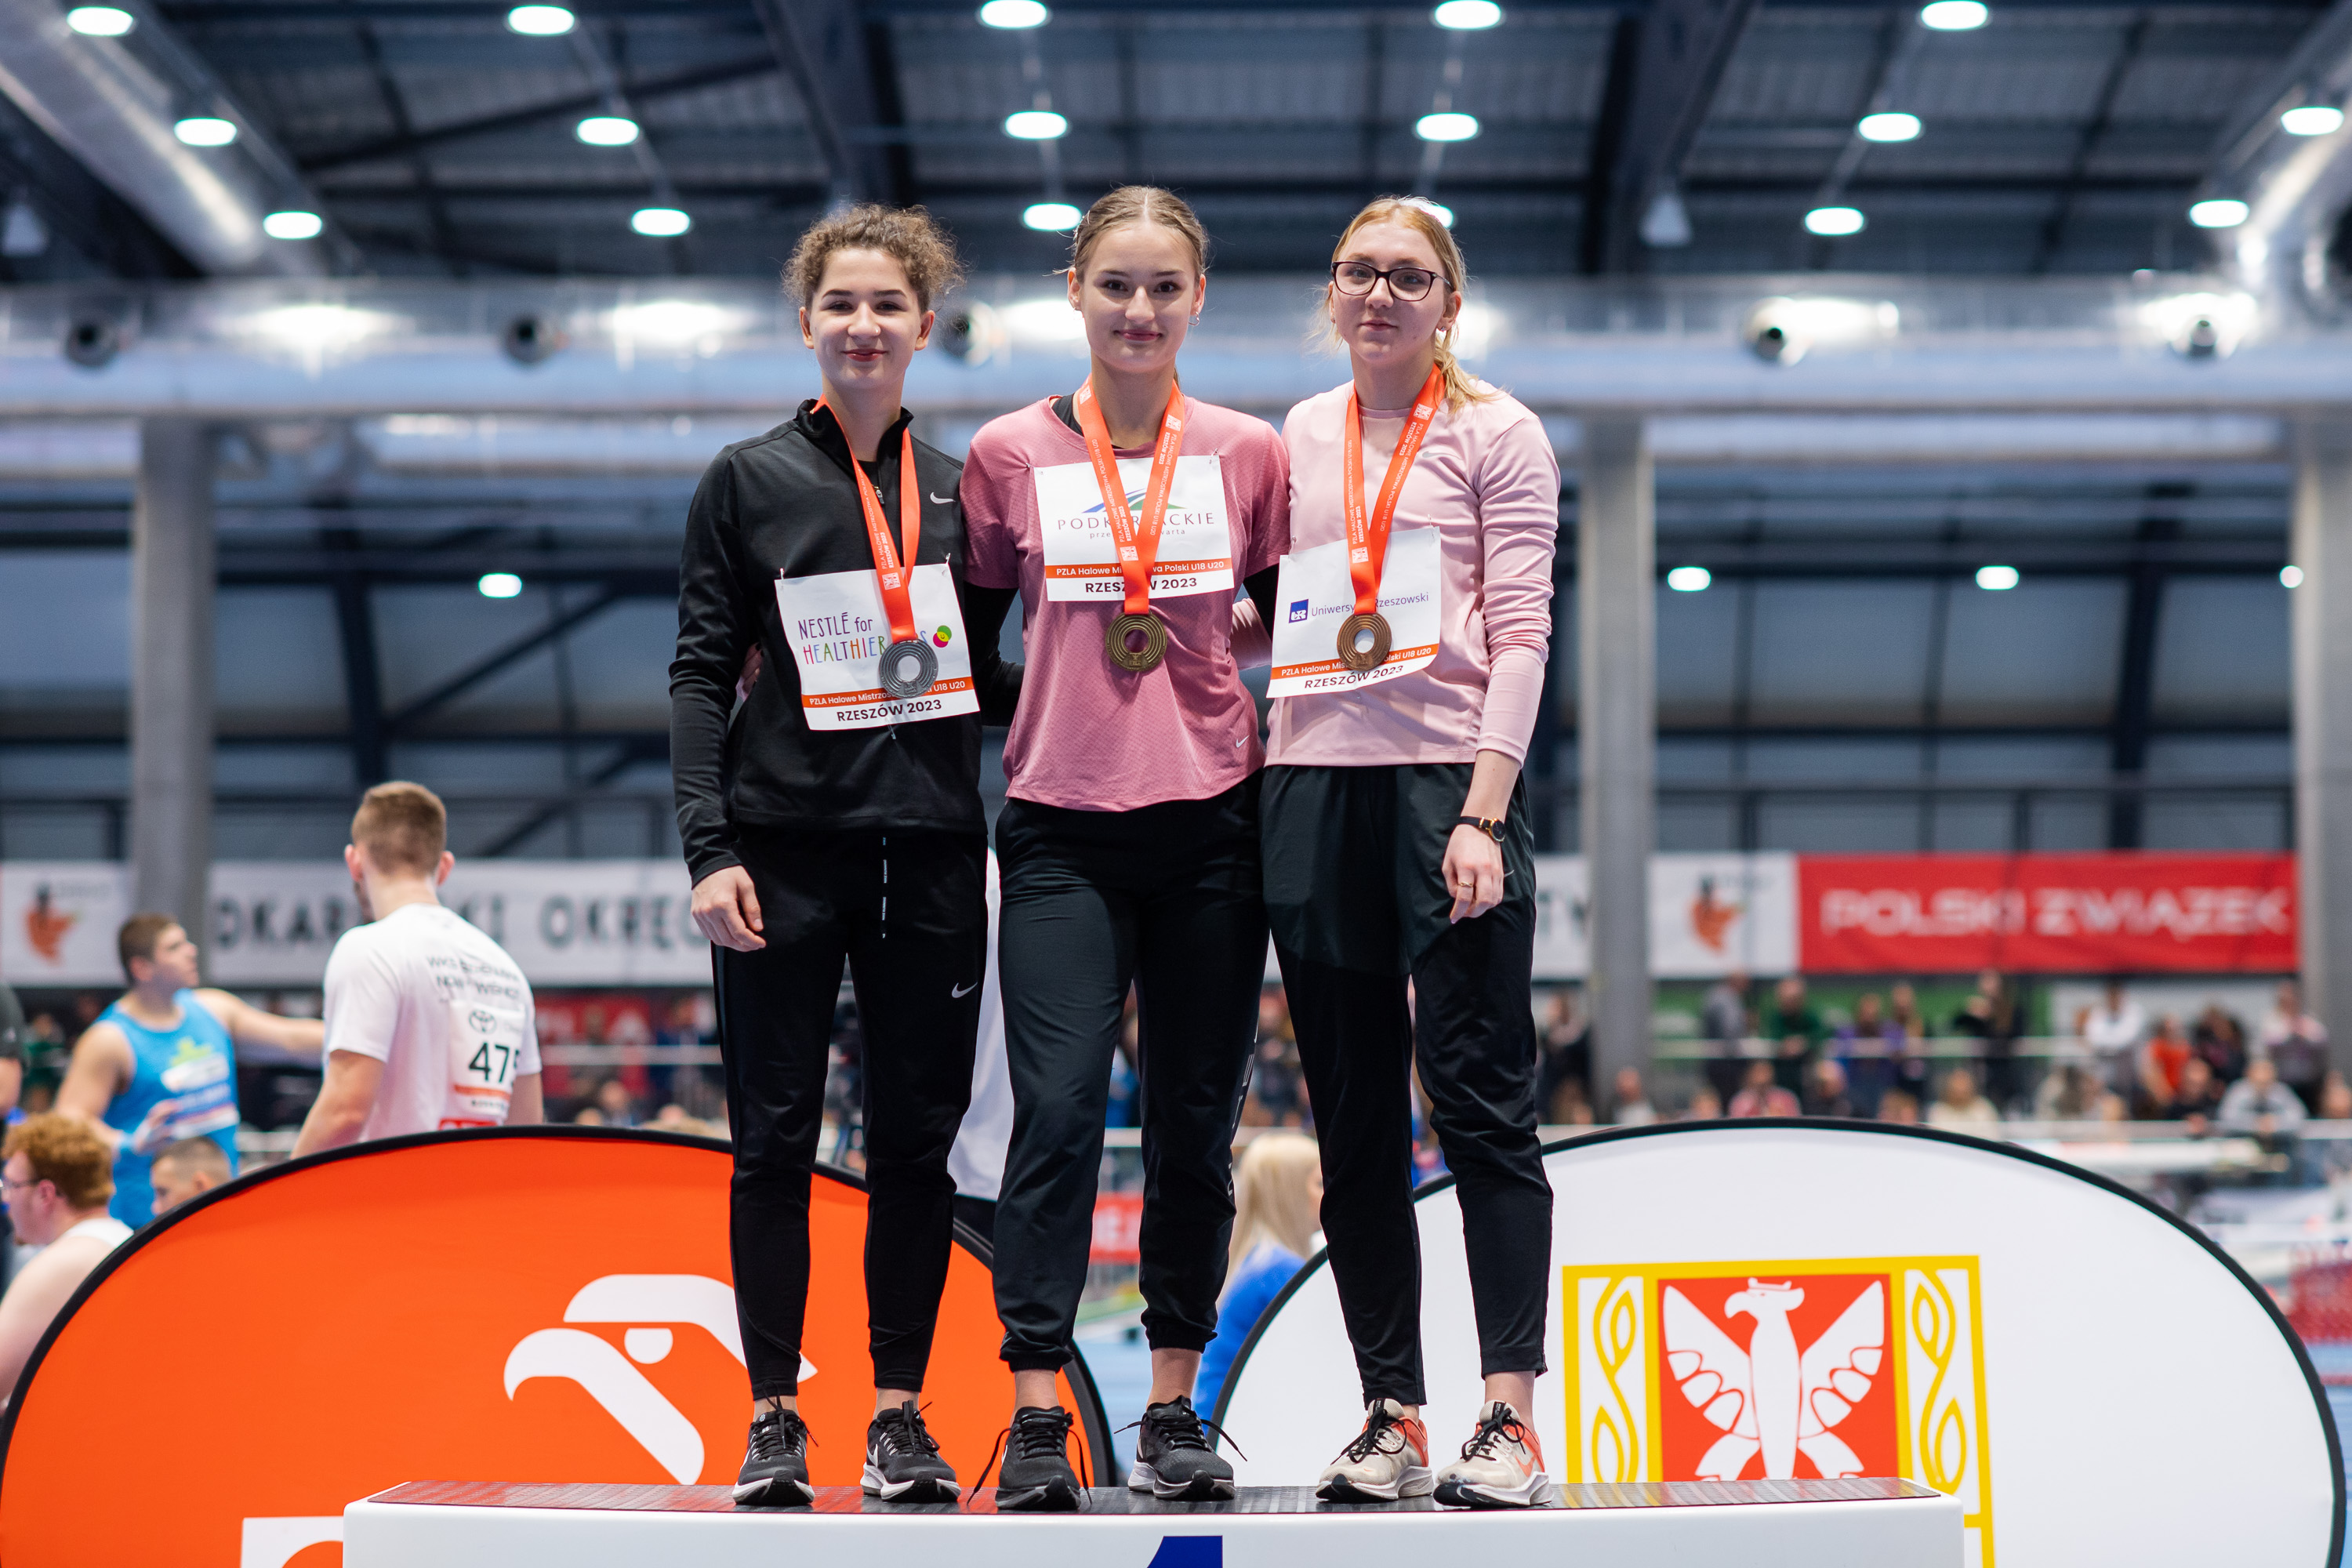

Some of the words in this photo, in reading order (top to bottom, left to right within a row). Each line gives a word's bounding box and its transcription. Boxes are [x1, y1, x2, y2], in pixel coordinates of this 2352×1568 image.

[1166, 445, 1174, 466] HALOWE
[1399, 444, 1408, 456] 2023
[1405, 435, 1418, 456] HALOWE
[1158, 466, 1171, 498] MISTRZOSTWA
[1392, 456, 1408, 490] MISTRZOSTWA
[1103, 474, 1116, 507] MISTRZOSTWA
[1386, 490, 1396, 508] POLSKI
[1058, 512, 1215, 530] PODKRCKIE
[1111, 507, 1121, 529] HALOWE
[874, 532, 884, 556] HALOWE
[1078, 567, 1110, 575] Halowe
[1164, 563, 1189, 572] Polski
[1191, 562, 1206, 571] U18
[1207, 561, 1224, 569] U20
[1161, 577, 1197, 590] 2023
[1312, 604, 1355, 616] Uniwersy
[798, 612, 851, 640] NESTLÉ
[854, 616, 873, 633] for
[803, 636, 886, 665] HEALTHIER
[1282, 667, 1300, 677] PZLA
[1301, 665, 1330, 674] Halowe
[1403, 650, 1415, 659] U18
[1417, 647, 1432, 656] U20
[1305, 671, 1370, 688] RZESZÓW
[1372, 665, 1403, 679] 2023
[828, 695, 857, 704] Halowe
[933, 682, 948, 691] U18
[949, 681, 966, 690] U20
[837, 703, 903, 721] RZESZÓW
[906, 699, 942, 713] 2023
[1818, 886, 2027, 937] POLSKI
[2035, 885, 2293, 942] ZWIĄZEK
